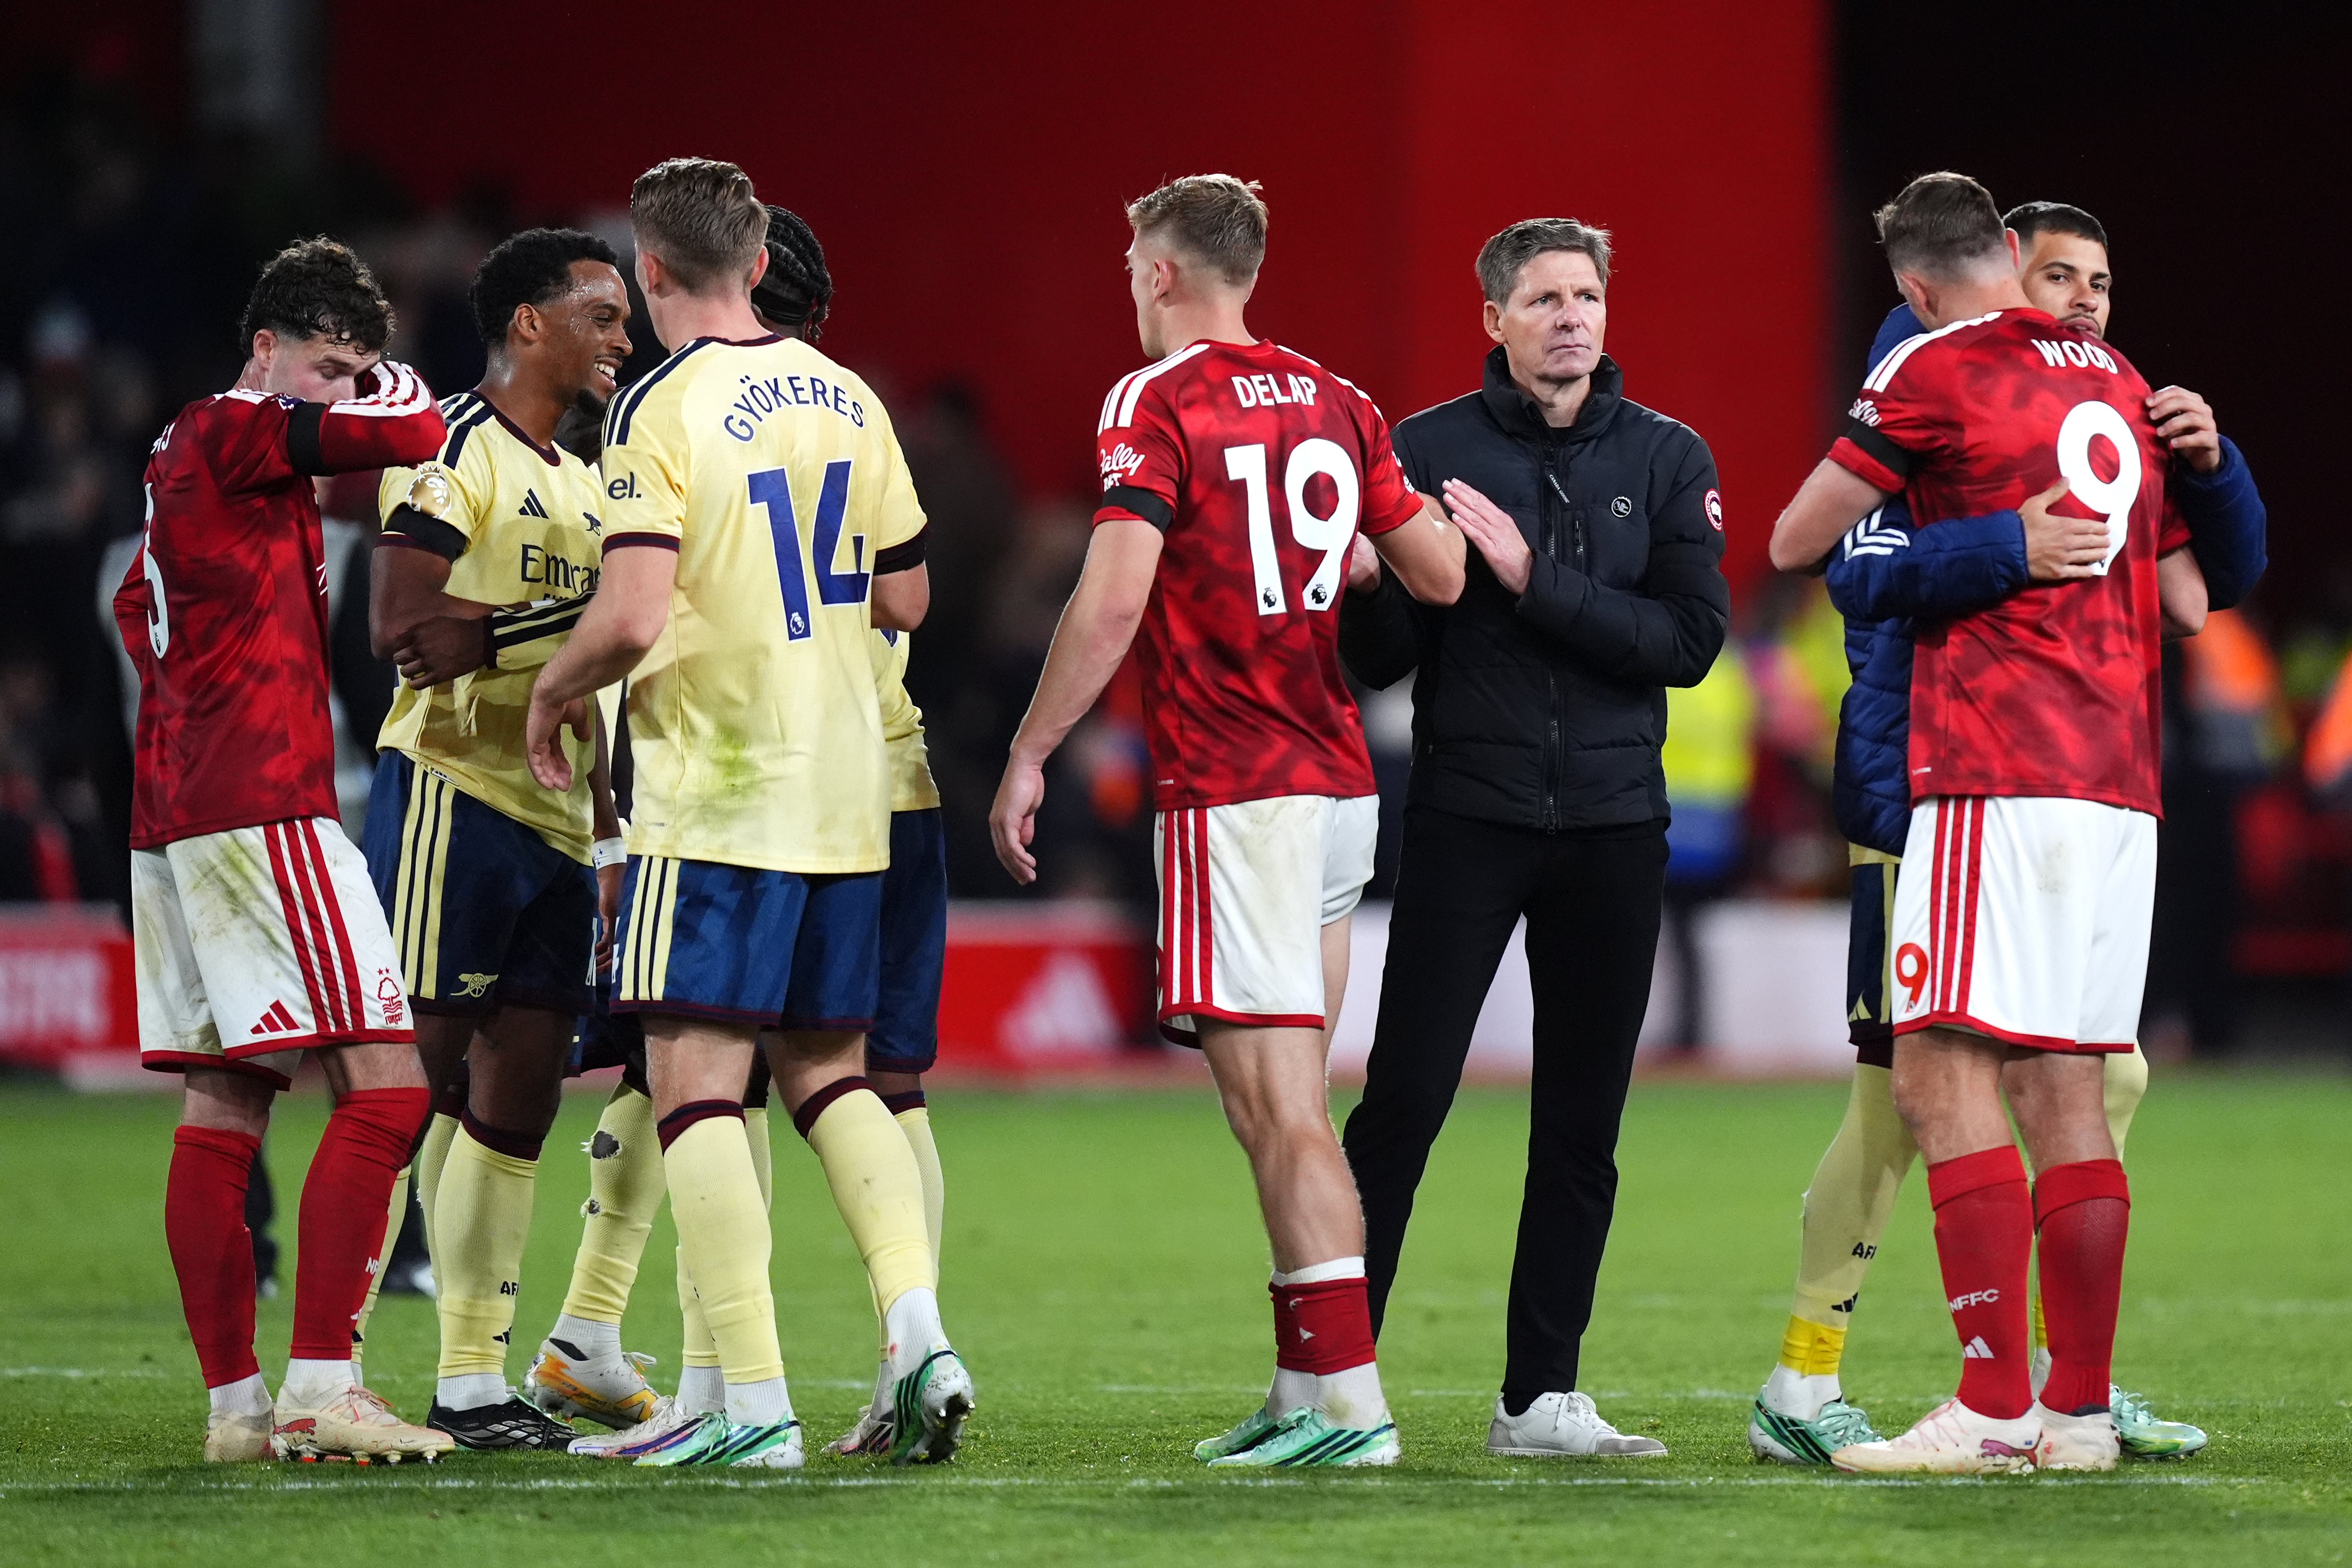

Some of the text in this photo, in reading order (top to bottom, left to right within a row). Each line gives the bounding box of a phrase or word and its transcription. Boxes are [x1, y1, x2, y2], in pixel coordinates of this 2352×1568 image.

[2030, 339, 2119, 374] WOOD
[723, 374, 864, 442] GYÖKERES
[1232, 373, 1317, 408] DELAP
[2057, 400, 2142, 576] 9
[747, 458, 872, 643] 14
[1224, 438, 1360, 616] 19
[1896, 943, 1929, 1013] 9
[1851, 1241, 1877, 1260] AF
[500, 1280, 519, 1296] AF
[1949, 1288, 2000, 1313] NFFC
